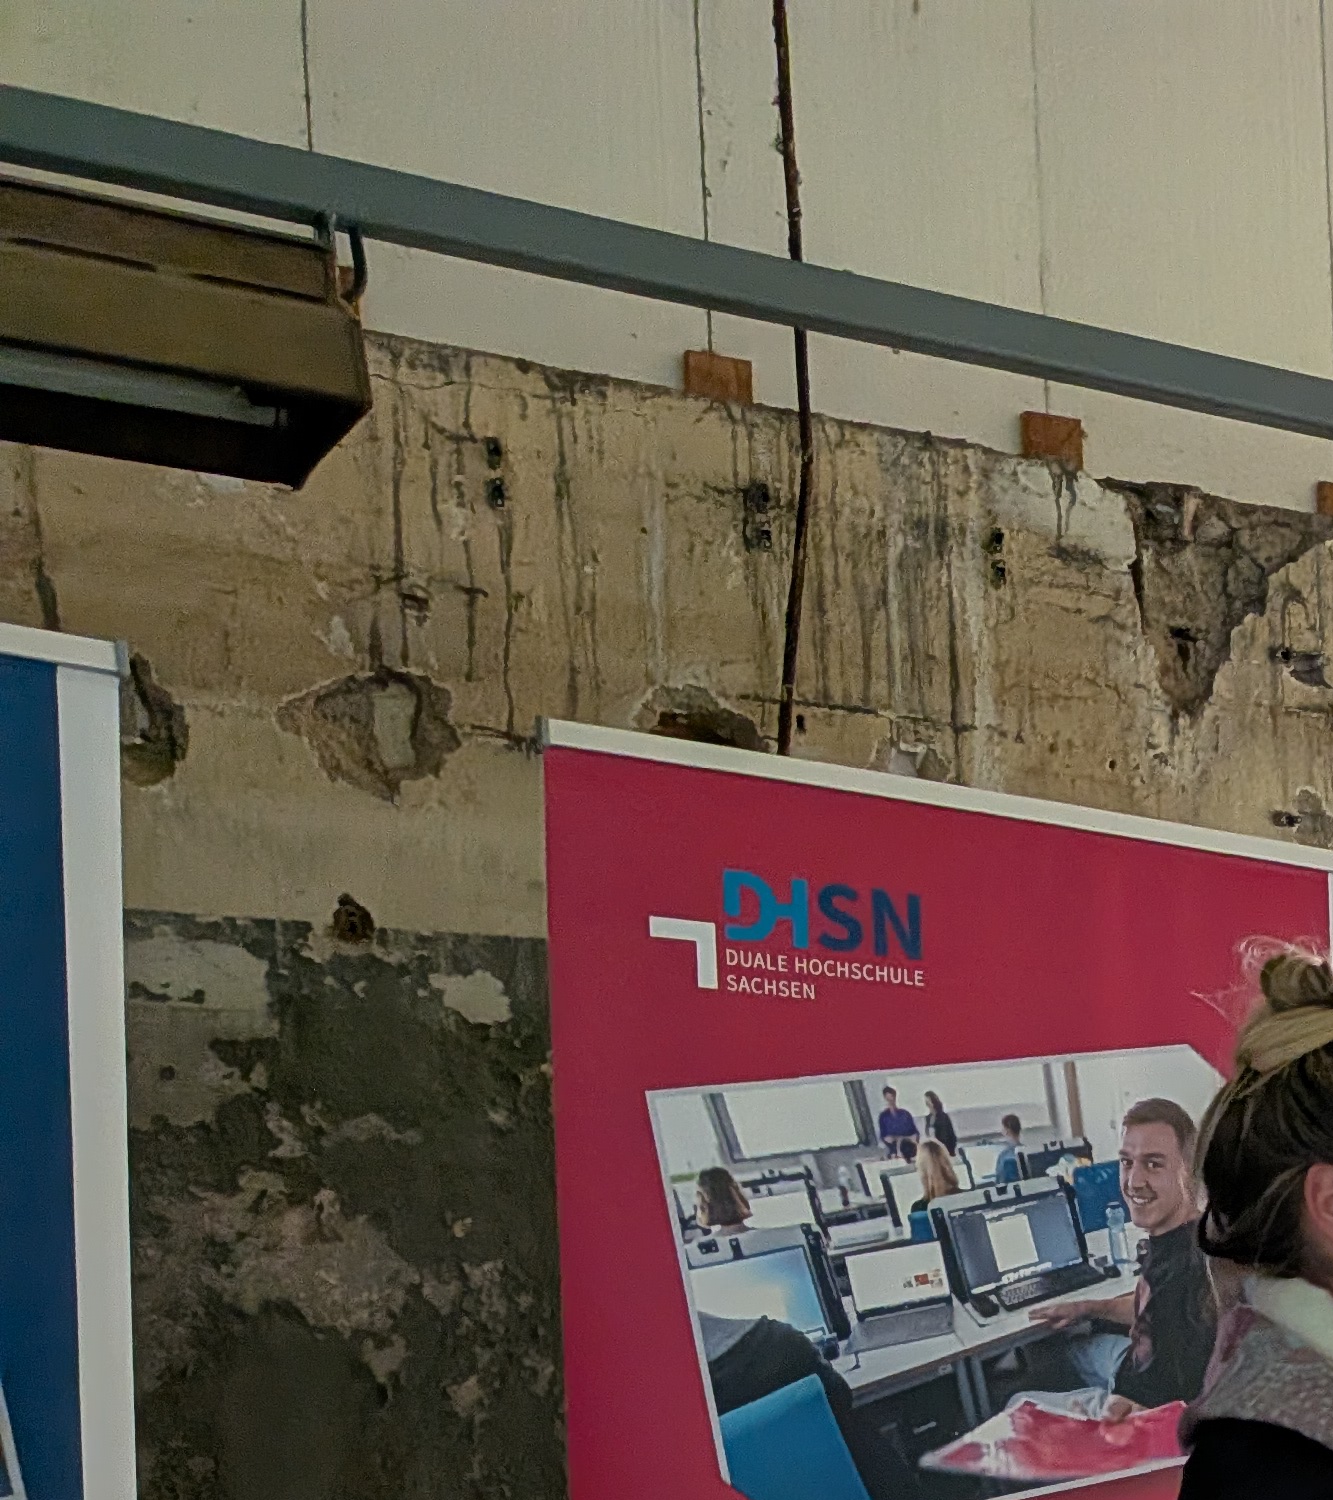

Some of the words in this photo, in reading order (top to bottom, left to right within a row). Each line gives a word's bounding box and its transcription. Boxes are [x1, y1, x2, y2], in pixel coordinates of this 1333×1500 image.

[723, 869, 922, 961] DHSN
[725, 948, 788, 973] DUALE
[795, 957, 925, 987] HOCHSCHULE
[726, 975, 816, 1000] SACHSEN
